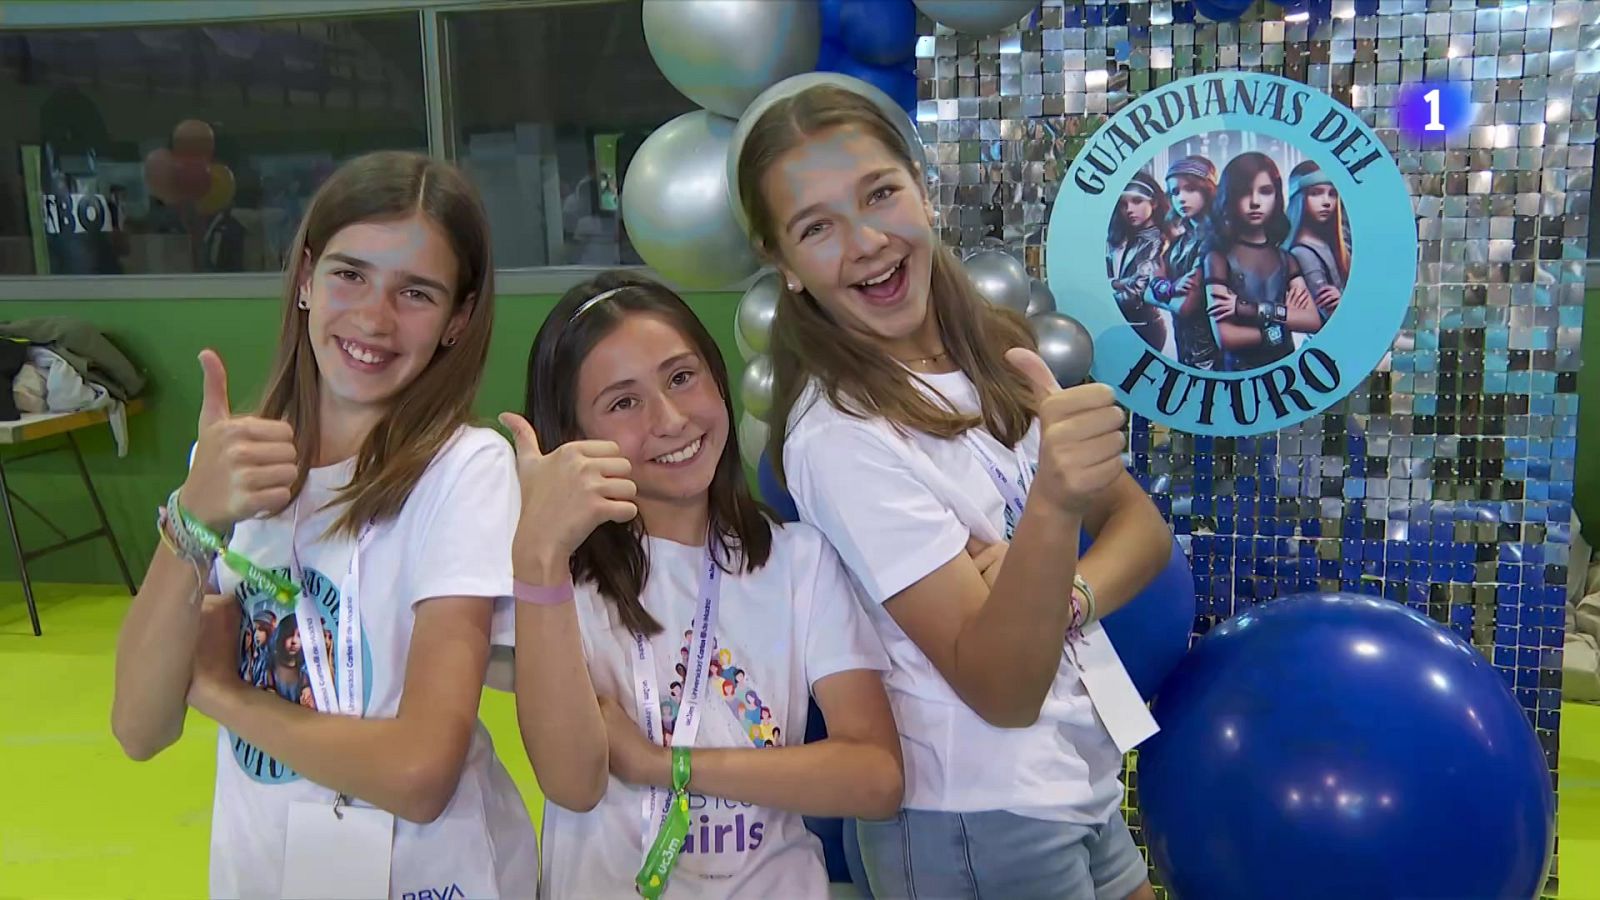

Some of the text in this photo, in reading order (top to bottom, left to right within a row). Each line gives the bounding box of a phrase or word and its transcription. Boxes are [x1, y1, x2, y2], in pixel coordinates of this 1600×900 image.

[1073, 77, 1385, 197] GUARDIANAS DEL
[1117, 346, 1341, 426] FUTURO
[698, 638, 707, 660] Carlos
[703, 598, 712, 622] Madrid
[346, 645, 354, 669] Carlos
[235, 736, 297, 779] FUTU
[658, 837, 681, 874] uc3m
